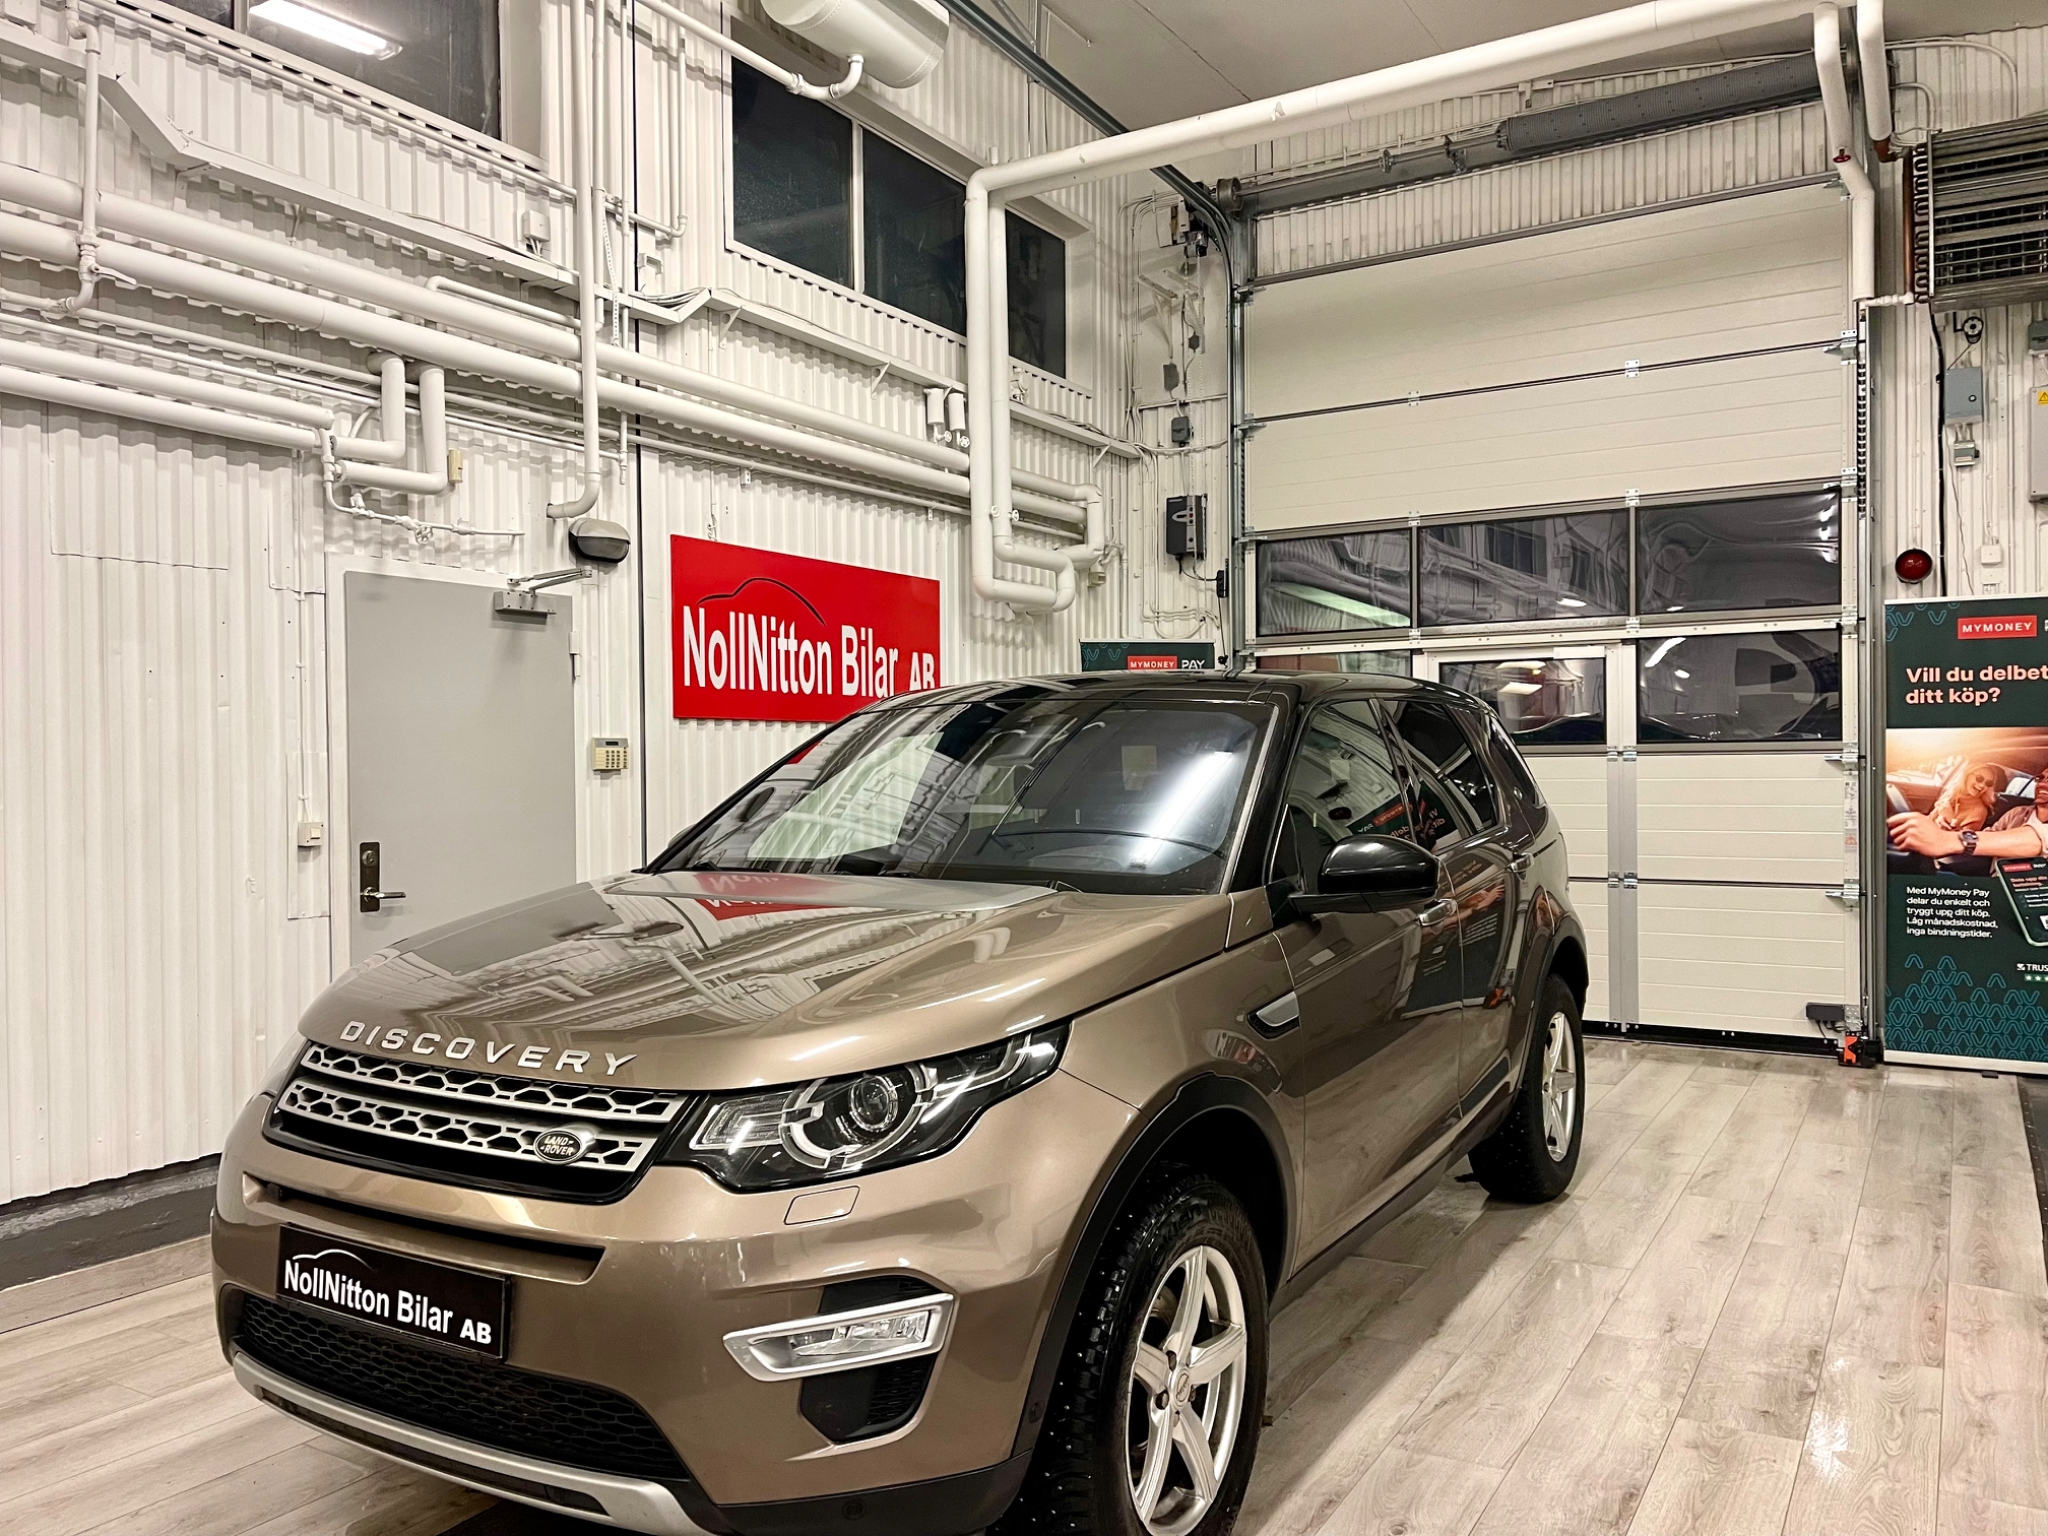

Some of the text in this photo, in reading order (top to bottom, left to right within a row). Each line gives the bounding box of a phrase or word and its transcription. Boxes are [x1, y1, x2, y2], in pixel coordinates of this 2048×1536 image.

[1962, 622, 2032, 633] MYMONEY
[683, 605, 935, 699] NollNitton Bilar AB
[1181, 660, 1205, 669] PAY
[1906, 667, 1941, 683] Vill
[1946, 667, 1974, 682] du
[1905, 687, 2001, 706] ditt köp?
[1906, 886, 1990, 898] Med MyMoney Pay
[1906, 897, 1929, 905] delar
[1906, 907, 1934, 916] tryggt
[1935, 909, 1953, 918] upp
[1971, 909, 1990, 918] köp.
[1906, 917, 1998, 928] Låg månadskostnad,
[1927, 928, 1992, 938] bindningstider.
[340, 1020, 637, 1076] DISCOVERY
[544, 1136, 569, 1146] LAND
[543, 1144, 574, 1156] ROVER
[284, 1260, 492, 1344] NollNitton Bilar AB
